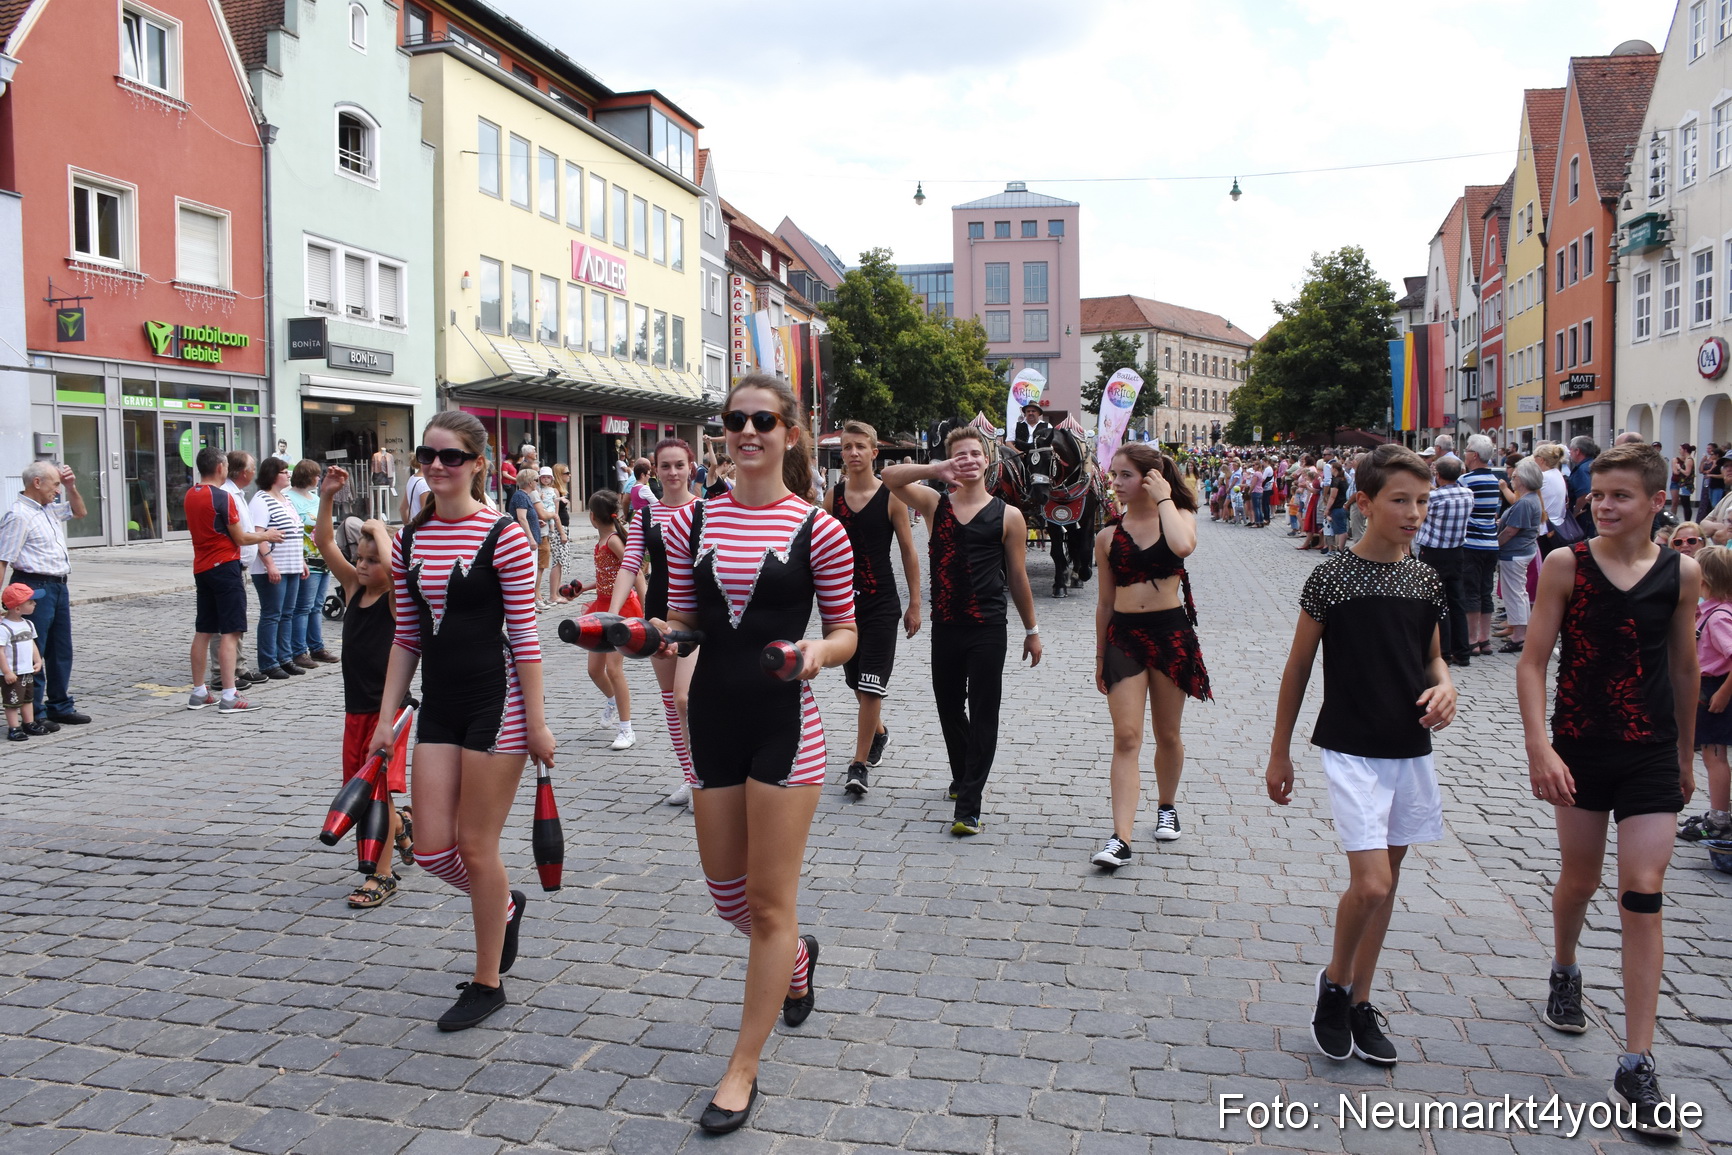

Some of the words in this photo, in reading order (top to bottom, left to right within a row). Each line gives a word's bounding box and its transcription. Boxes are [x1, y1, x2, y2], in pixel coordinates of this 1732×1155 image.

[578, 245, 626, 291] ADLER
[183, 325, 250, 347] mobilcom
[183, 343, 223, 364] debitel
[1701, 348, 1717, 368] C&A
[1571, 375, 1594, 383] MATT
[124, 395, 153, 407] GRAVIS
[606, 416, 630, 434] ADLER
